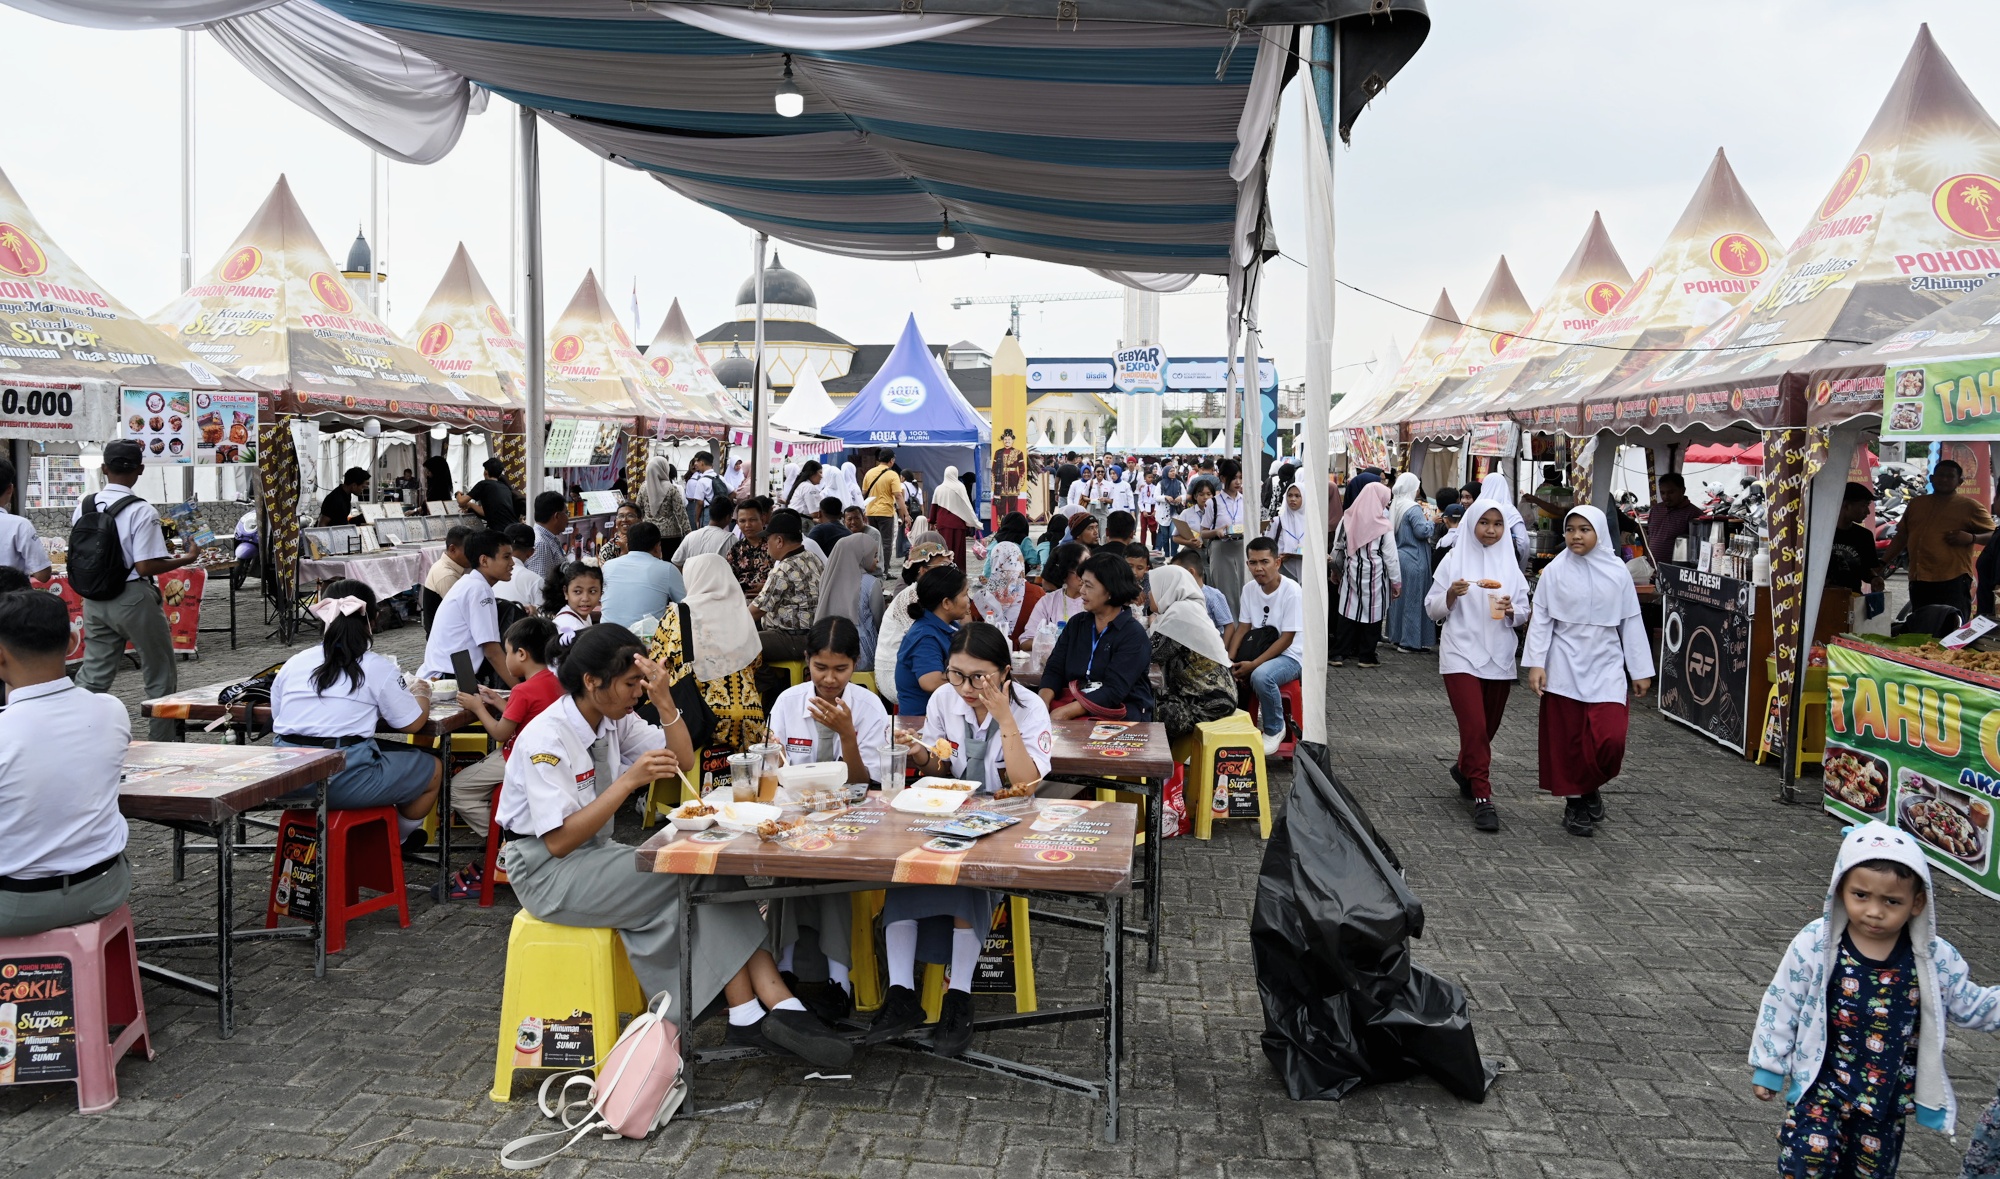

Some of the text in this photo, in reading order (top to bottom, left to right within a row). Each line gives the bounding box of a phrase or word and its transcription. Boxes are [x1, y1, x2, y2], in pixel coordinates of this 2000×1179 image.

[1815, 214, 1873, 243] PINANG
[1894, 248, 2000, 275] POHON
[1683, 279, 1747, 295] POHON
[1911, 276, 1984, 292] Ahlinya
[35, 280, 109, 308] PINANG
[226, 285, 276, 299] PINANG
[217, 308, 275, 320] Kualitas
[184, 312, 272, 343] Super
[301, 315, 351, 331] POHON
[10, 321, 100, 351] Super
[187, 342, 236, 354] Minuman
[108, 351, 158, 366] SUMUT
[342, 346, 394, 373] Super
[1117, 347, 1160, 367] GEBYAR
[332, 364, 375, 380] Minuman
[561, 366, 600, 376] PINANG
[1126, 361, 1150, 372] EXPO
[1085, 371, 1108, 380] Disdik
[887, 385, 920, 397] AQUA
[1831, 375, 1885, 394] POHON PINANG
[30, 422, 57, 430] KOREAN
[869, 430, 897, 443] AQUA
[1679, 568, 1721, 591] REAL FRESH
[1687, 584, 1711, 596] SLOW BAR
[1827, 675, 1963, 758] TAHU
[1229, 778, 1255, 791] Super
[1022, 833, 1101, 846] Super
[1059, 845, 1098, 853] POHON
[292, 866, 316, 884] Super
[18, 962, 63, 971] POHON PINANG
[979, 962, 994, 970] Khas
[981, 970, 1004, 979] SUMUT
[0, 978, 67, 1002] GOKIL
[32, 1009, 64, 1017] Kualitas
[17, 1012, 69, 1033] Super
[550, 1023, 580, 1033] Minuman
[24, 1035, 60, 1046] Minuman
[554, 1032, 571, 1040] Khas
[29, 1044, 48, 1053] Khas
[555, 1041, 582, 1050] SUMUT
[31, 1052, 61, 1063] SUMUT
